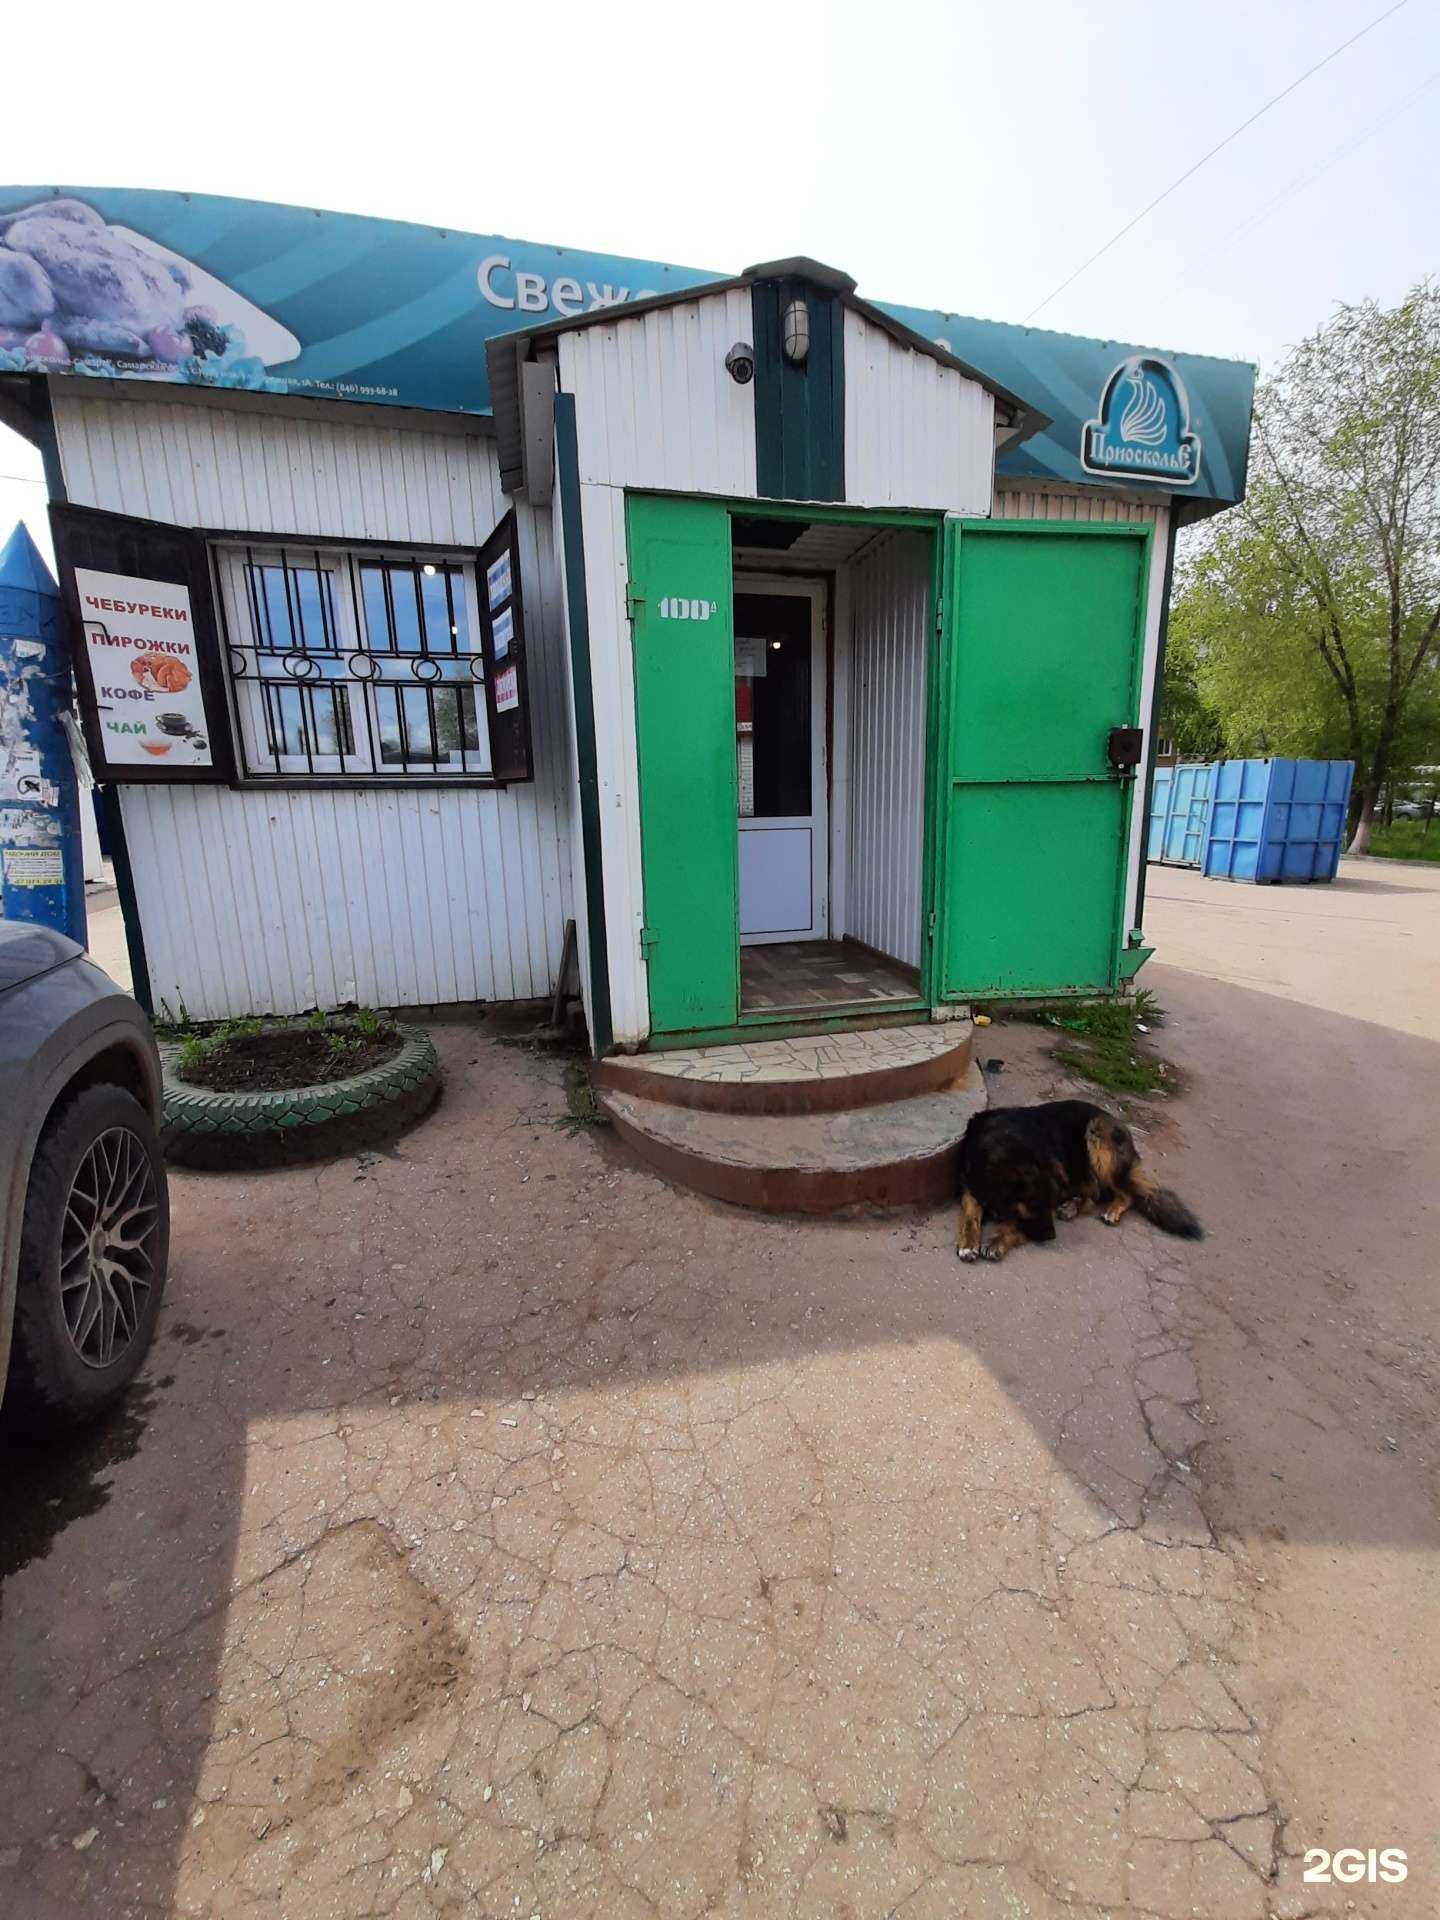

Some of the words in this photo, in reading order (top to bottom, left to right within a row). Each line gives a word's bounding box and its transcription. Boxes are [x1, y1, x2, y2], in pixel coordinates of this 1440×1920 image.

[85, 595, 188, 622] ЧЕБУРЕКИ
[91, 631, 190, 655] ПИРОЖКИ
[101, 686, 156, 701] КОФЕ
[106, 720, 147, 735] ЧАЙ
